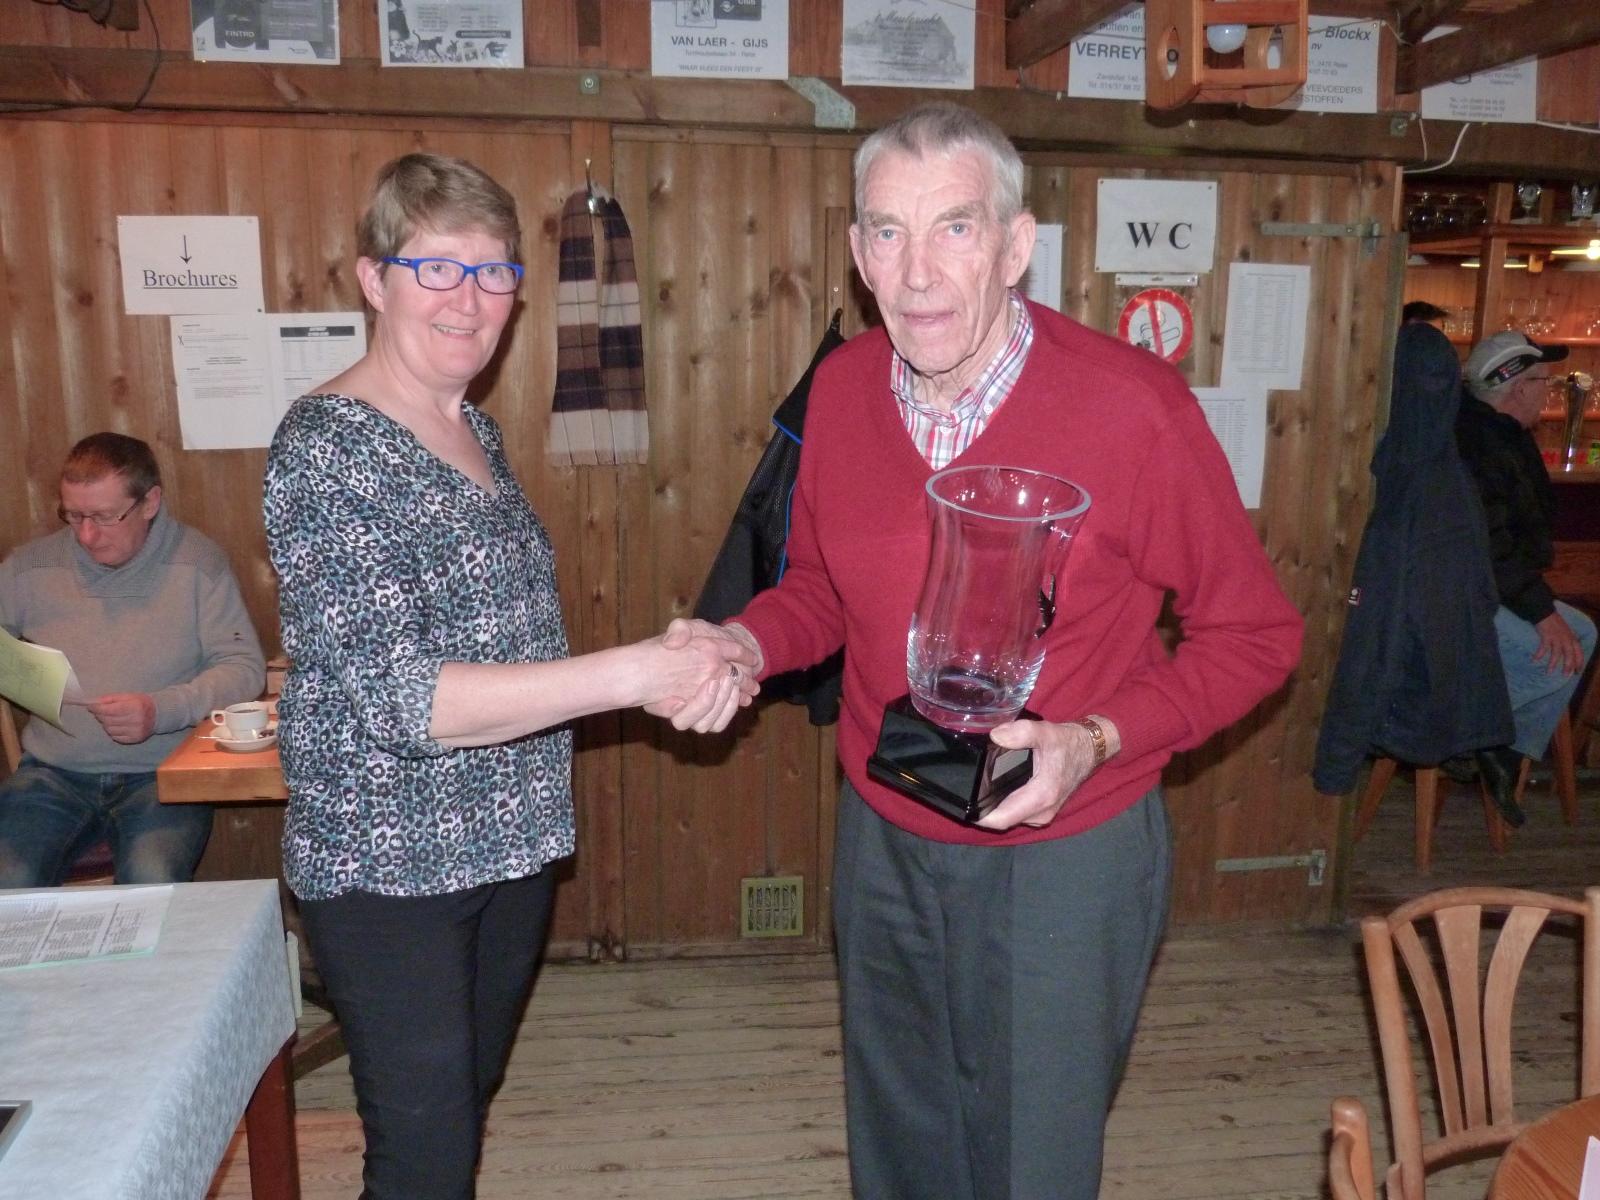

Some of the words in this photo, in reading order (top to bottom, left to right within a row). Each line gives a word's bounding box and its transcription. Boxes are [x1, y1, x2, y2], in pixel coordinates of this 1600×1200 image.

[225, 30, 255, 38] FINTRO
[1325, 25, 1372, 41] Blockx
[671, 36, 694, 46] VAN
[698, 37, 727, 47] LAER
[743, 38, 769, 48] GIJS
[143, 269, 238, 288] Brochures
